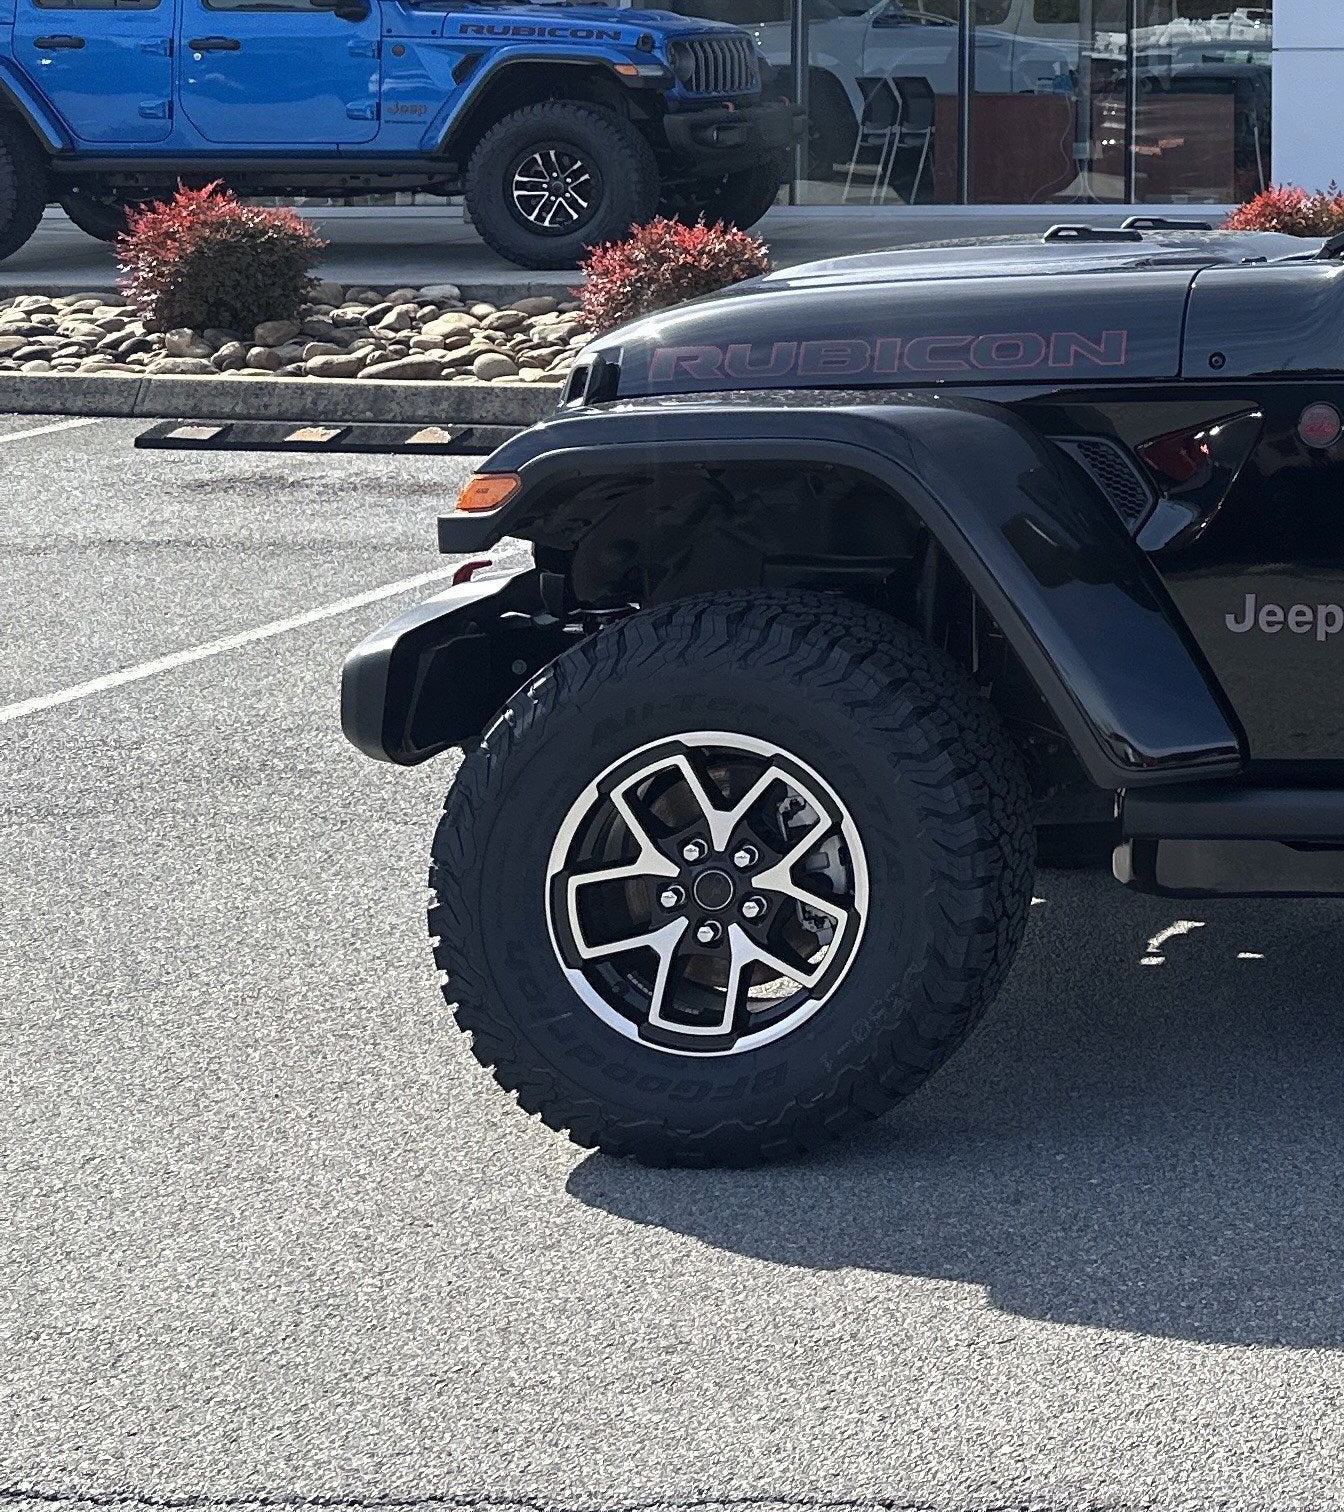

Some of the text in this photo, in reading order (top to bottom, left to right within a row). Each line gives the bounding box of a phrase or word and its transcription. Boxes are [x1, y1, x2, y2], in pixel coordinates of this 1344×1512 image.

[458, 23, 622, 41] RUBICON
[387, 101, 428, 117] Jeep
[647, 330, 1128, 383] RUBICON
[1225, 593, 1344, 641] Jeep
